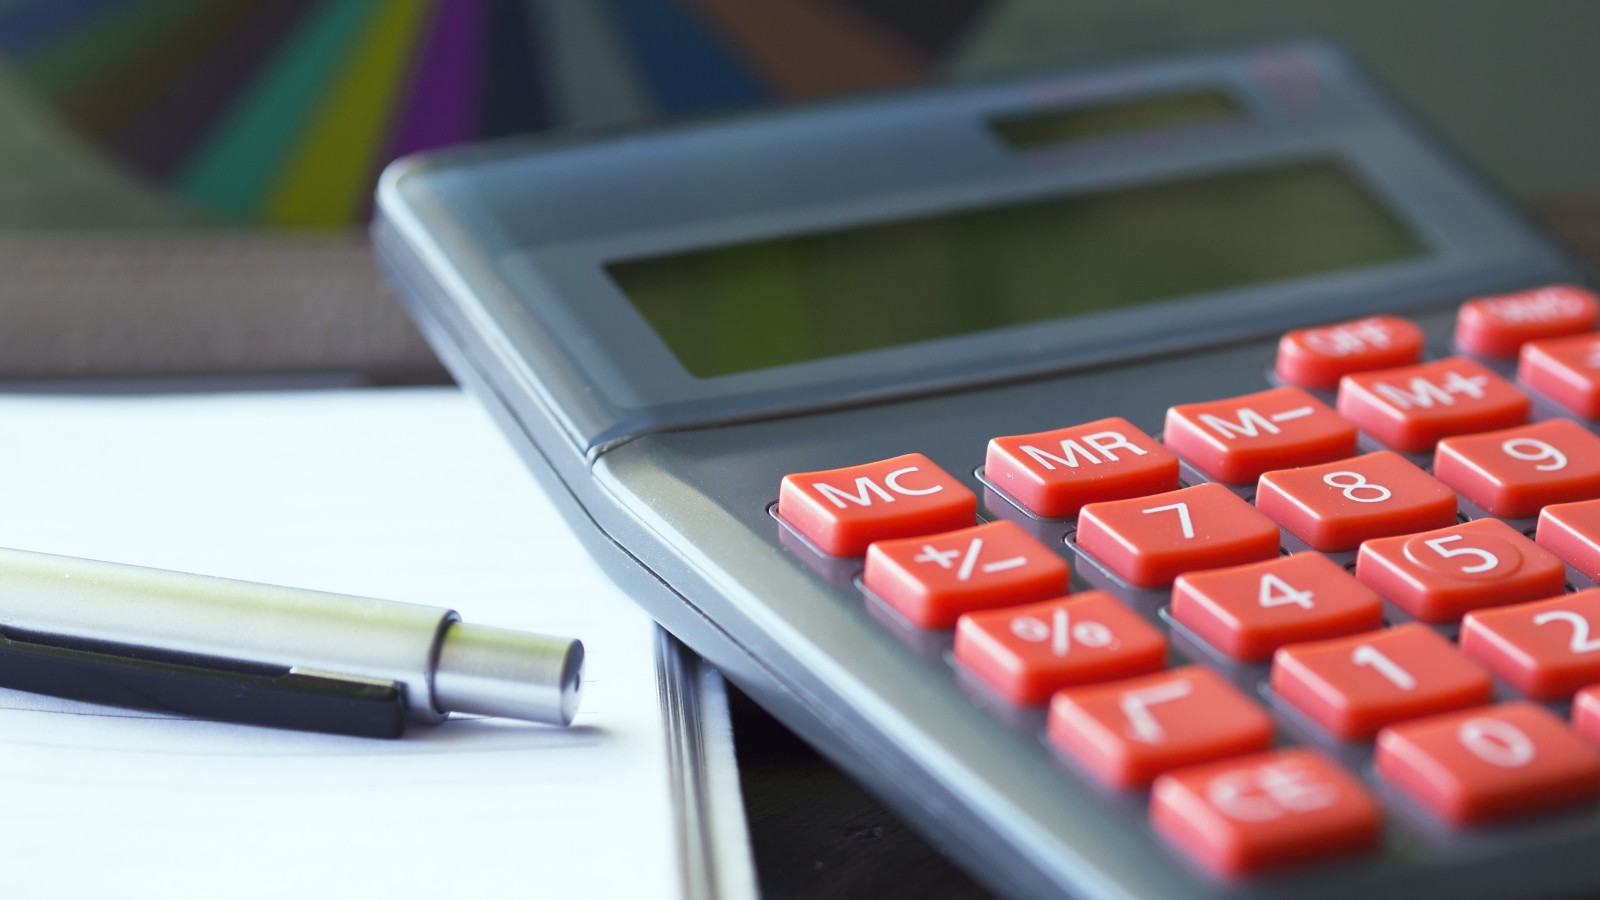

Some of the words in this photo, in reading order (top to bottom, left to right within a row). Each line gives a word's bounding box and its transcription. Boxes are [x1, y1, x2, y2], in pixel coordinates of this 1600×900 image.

[1370, 371, 1489, 409] M+
[1019, 430, 1147, 471] MR
[1502, 437, 1568, 471] 9
[812, 466, 943, 509] MC
[1323, 471, 1391, 503] 8
[1142, 502, 1195, 539] 7
[1424, 534, 1499, 574] 5
[1258, 573, 1315, 610] 4
[1009, 608, 1114, 656] %
[1532, 610, 1600, 653] 2
[1352, 645, 1417, 691] 1
